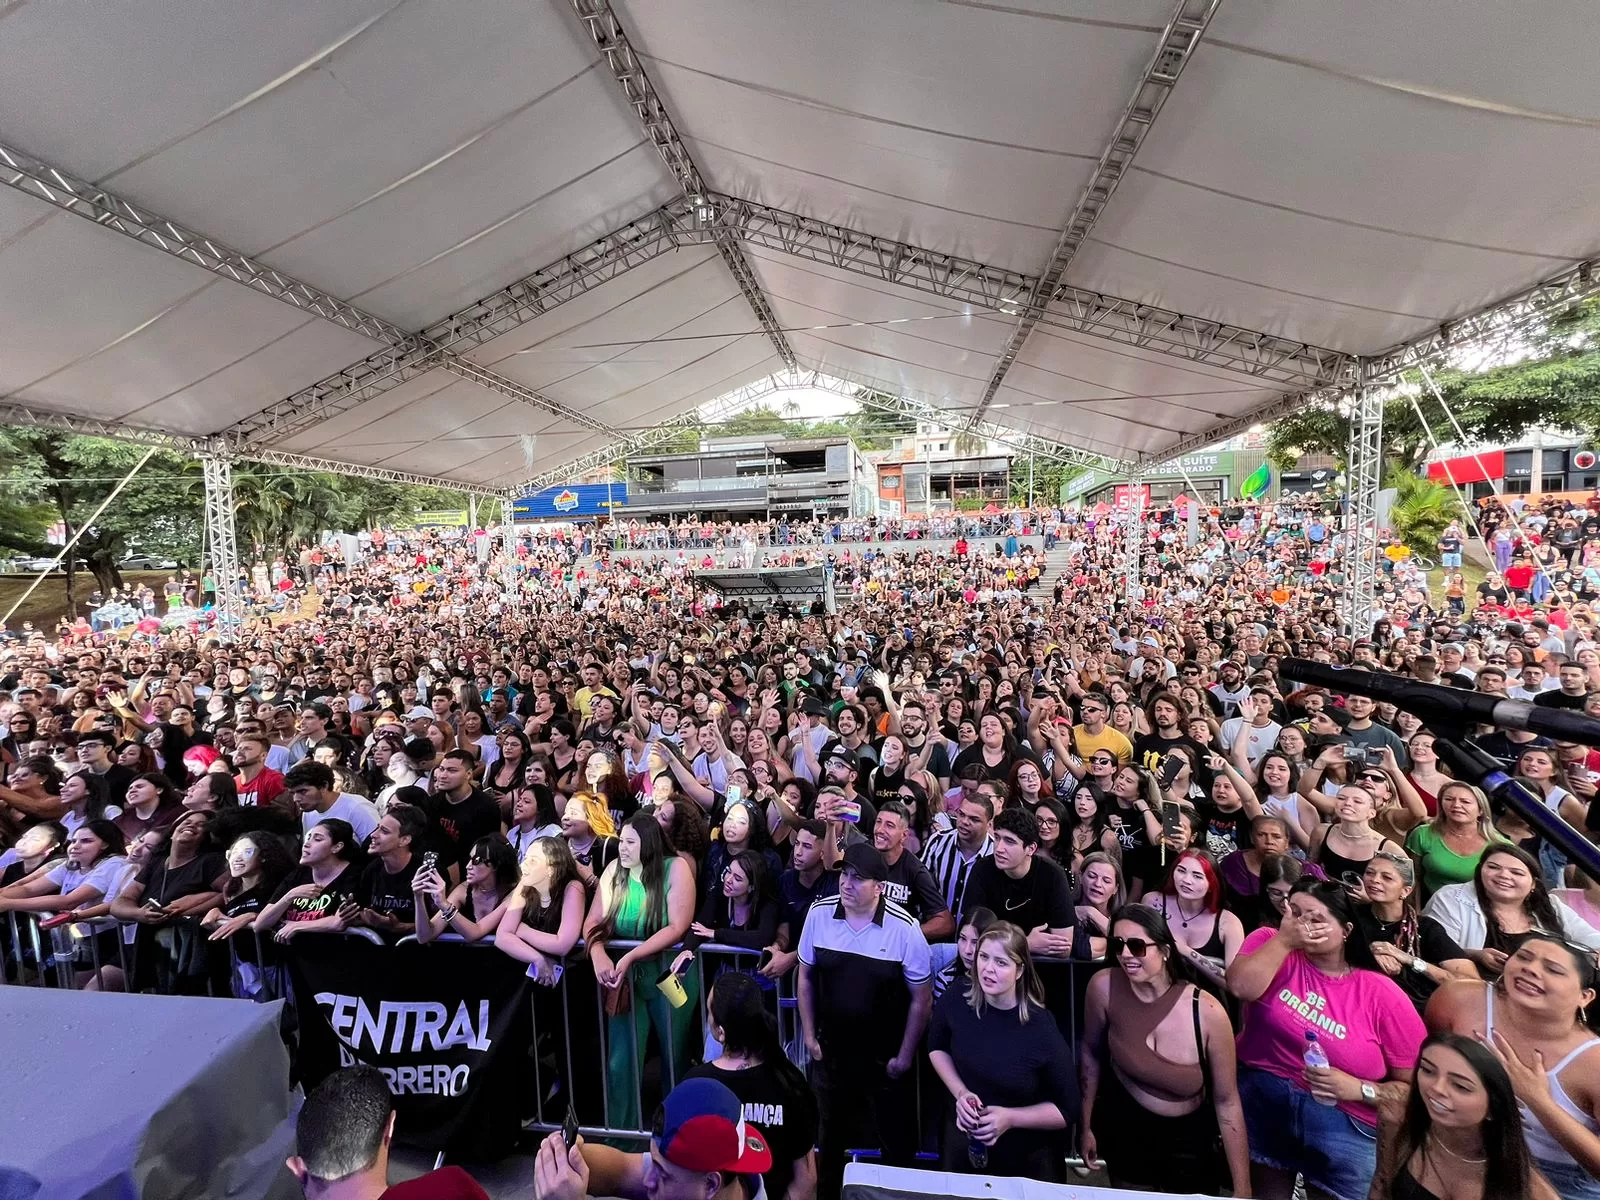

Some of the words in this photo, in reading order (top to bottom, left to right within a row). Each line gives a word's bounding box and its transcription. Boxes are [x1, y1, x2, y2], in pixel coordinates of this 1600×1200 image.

[1184, 455, 1218, 466] SUÍTE
[1160, 465, 1213, 474] DECORADO
[1306, 991, 1327, 1011] BE
[1279, 989, 1347, 1039] ORGANIC
